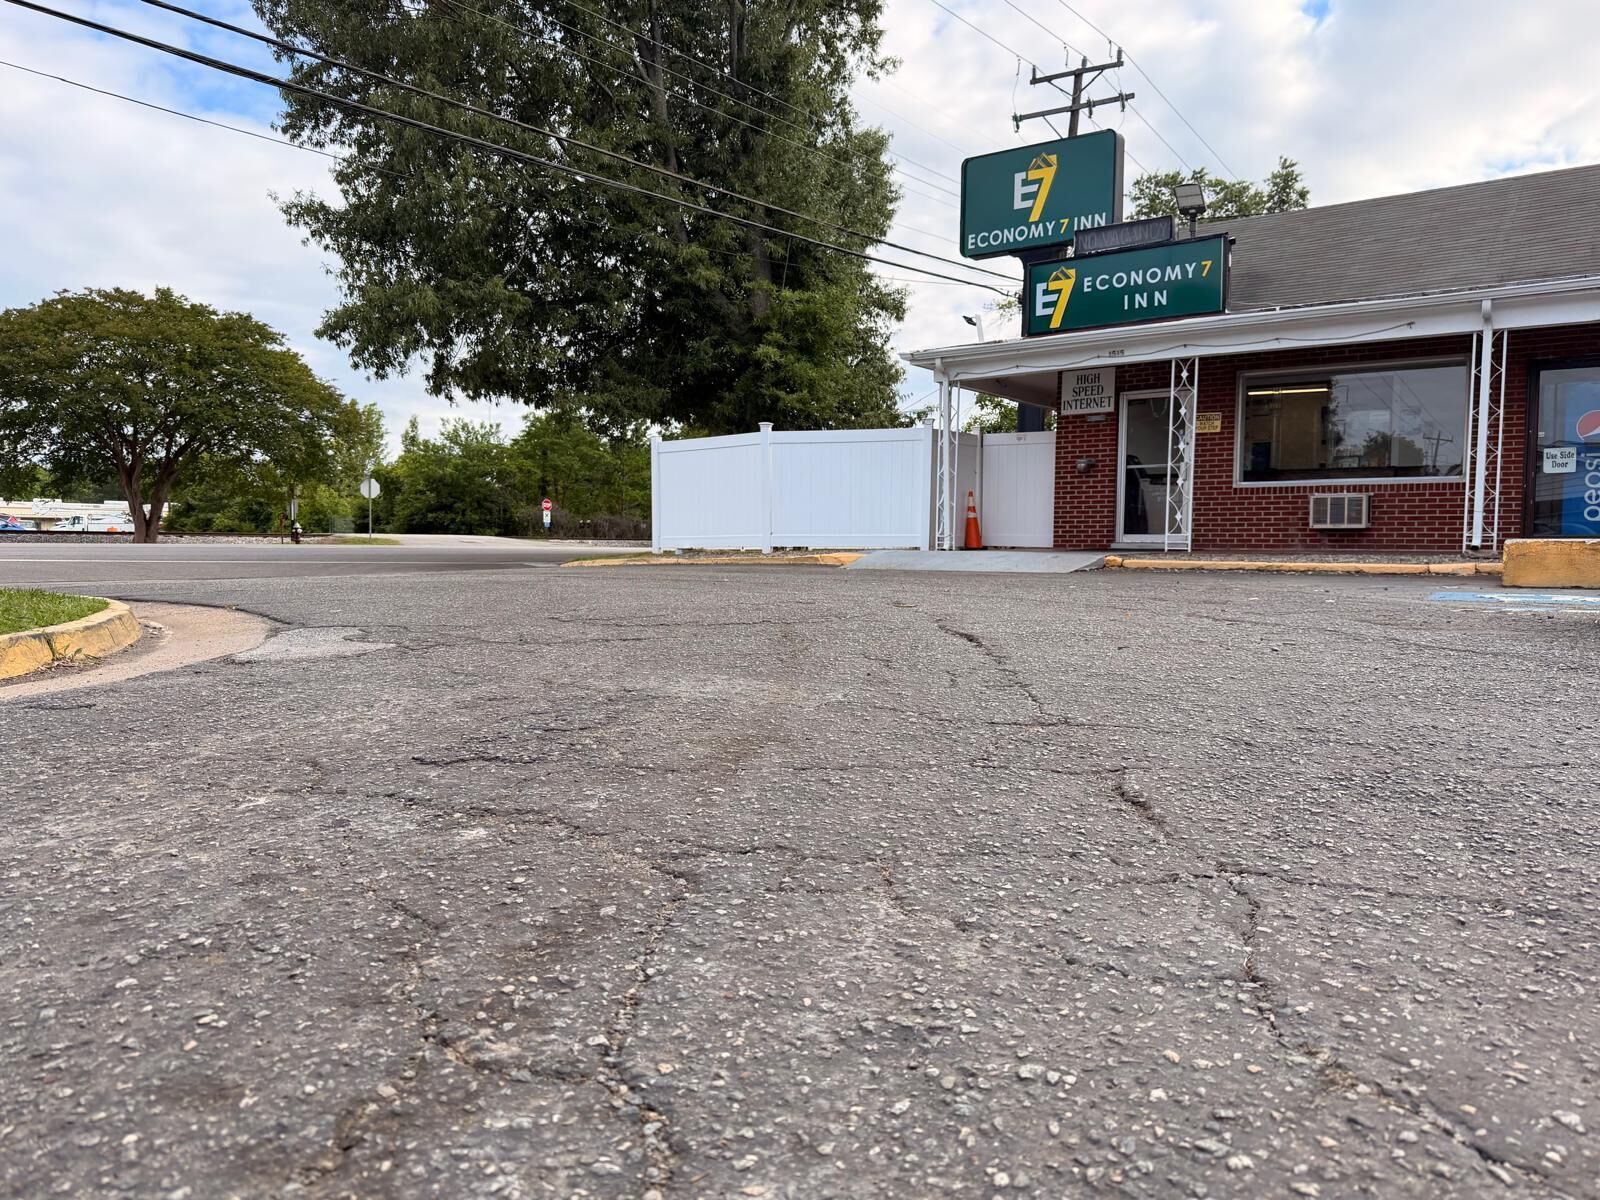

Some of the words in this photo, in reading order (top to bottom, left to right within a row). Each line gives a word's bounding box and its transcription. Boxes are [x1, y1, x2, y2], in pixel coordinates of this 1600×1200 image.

[968, 221, 1055, 249] ECONOMY
[1060, 219, 1069, 234] 7
[1074, 213, 1107, 231] INN
[1078, 231, 1096, 250] NO
[1102, 221, 1168, 245] VACANCY
[1083, 262, 1197, 292] ECONOMY
[1201, 260, 1212, 277] 7
[1124, 290, 1168, 310] INN
[1076, 373, 1100, 385] HIGH
[1072, 385, 1104, 397] SPEED
[1063, 396, 1112, 410] INTERNET
[1559, 450, 1575, 459] Side
[1551, 460, 1568, 468] Door
